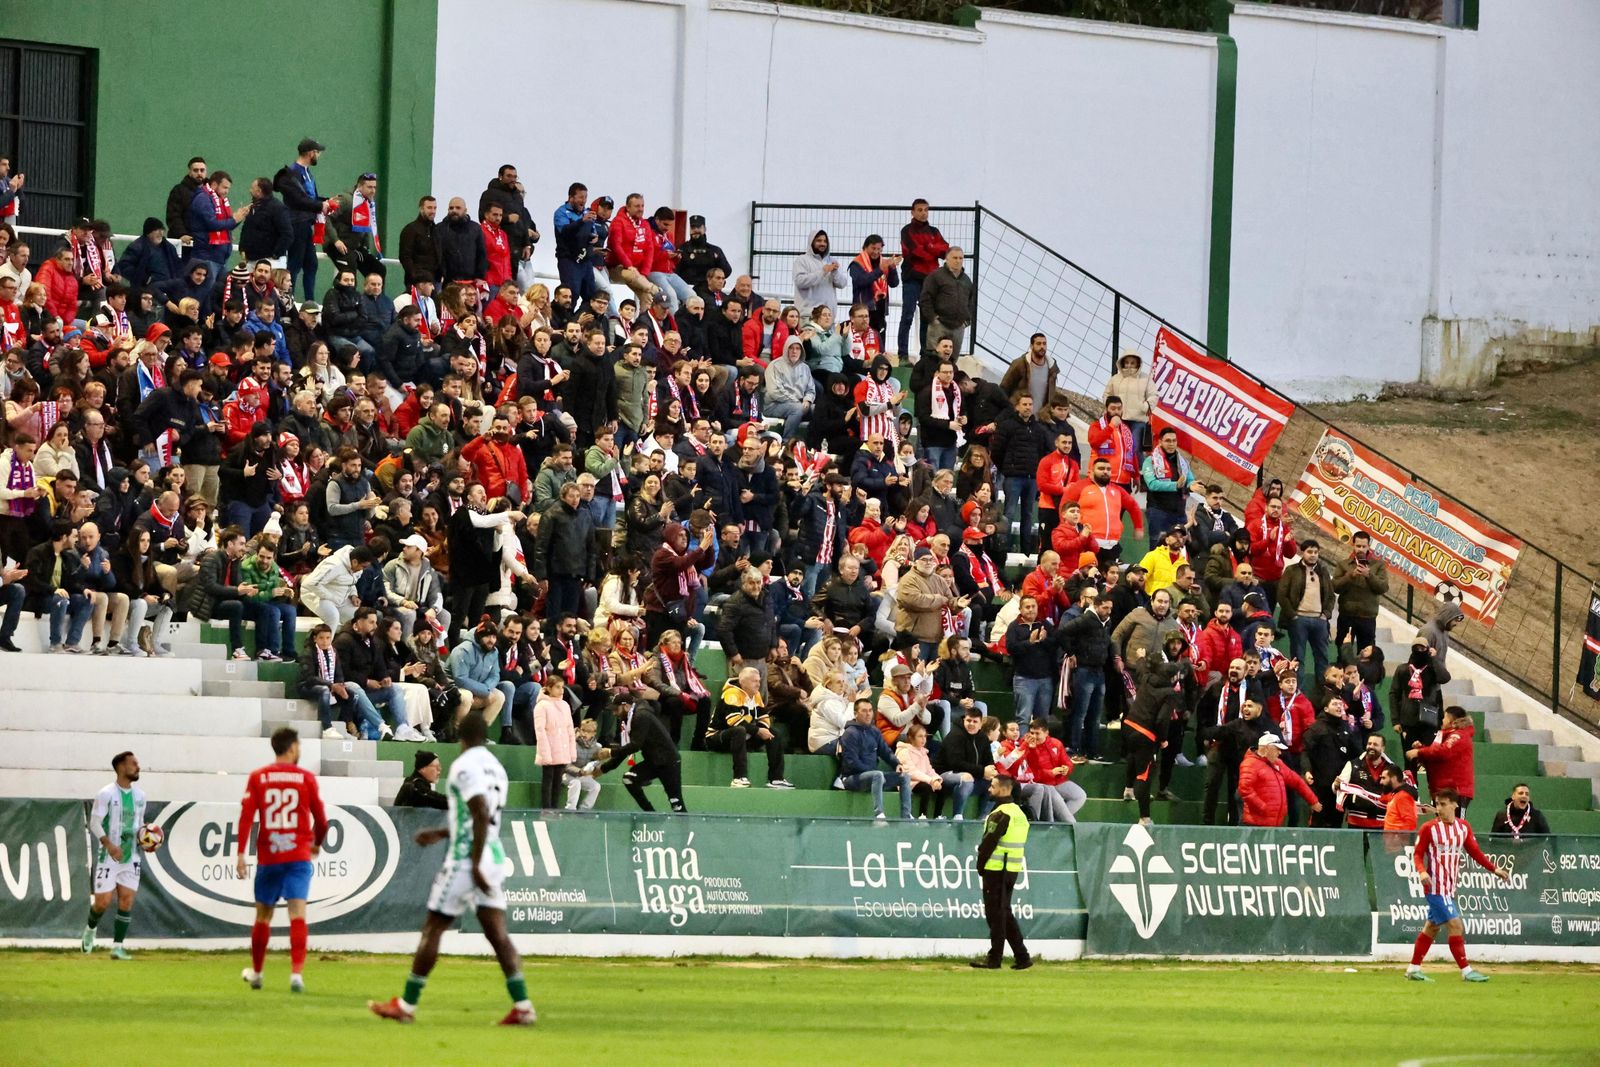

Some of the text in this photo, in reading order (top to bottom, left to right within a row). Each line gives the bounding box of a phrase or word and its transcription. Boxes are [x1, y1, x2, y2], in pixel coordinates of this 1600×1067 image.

[1404, 484, 1439, 517] PEÑA
[1352, 473, 1487, 563] LOS EXCURSIONISTAS
[265, 788, 298, 830] 22
[631, 823, 665, 843] sabor
[632, 831, 703, 881] a má
[846, 840, 887, 888] La
[1181, 842, 1337, 876] SCIENTIFFIC
[1560, 854, 1578, 870] 952
[704, 877, 742, 888] PRODUCTOS
[540, 888, 587, 903] Provincial
[634, 868, 708, 927] laga
[706, 889, 749, 902] AUTÓCTONOS
[1457, 894, 1493, 916] para
[1493, 892, 1509, 912] tu
[512, 906, 563, 925] de Málaga
[708, 905, 763, 915] DE LA PROVINCIA
[854, 896, 918, 918] Escuela
[922, 898, 944, 919] de
[1463, 913, 1522, 936] vivienda
